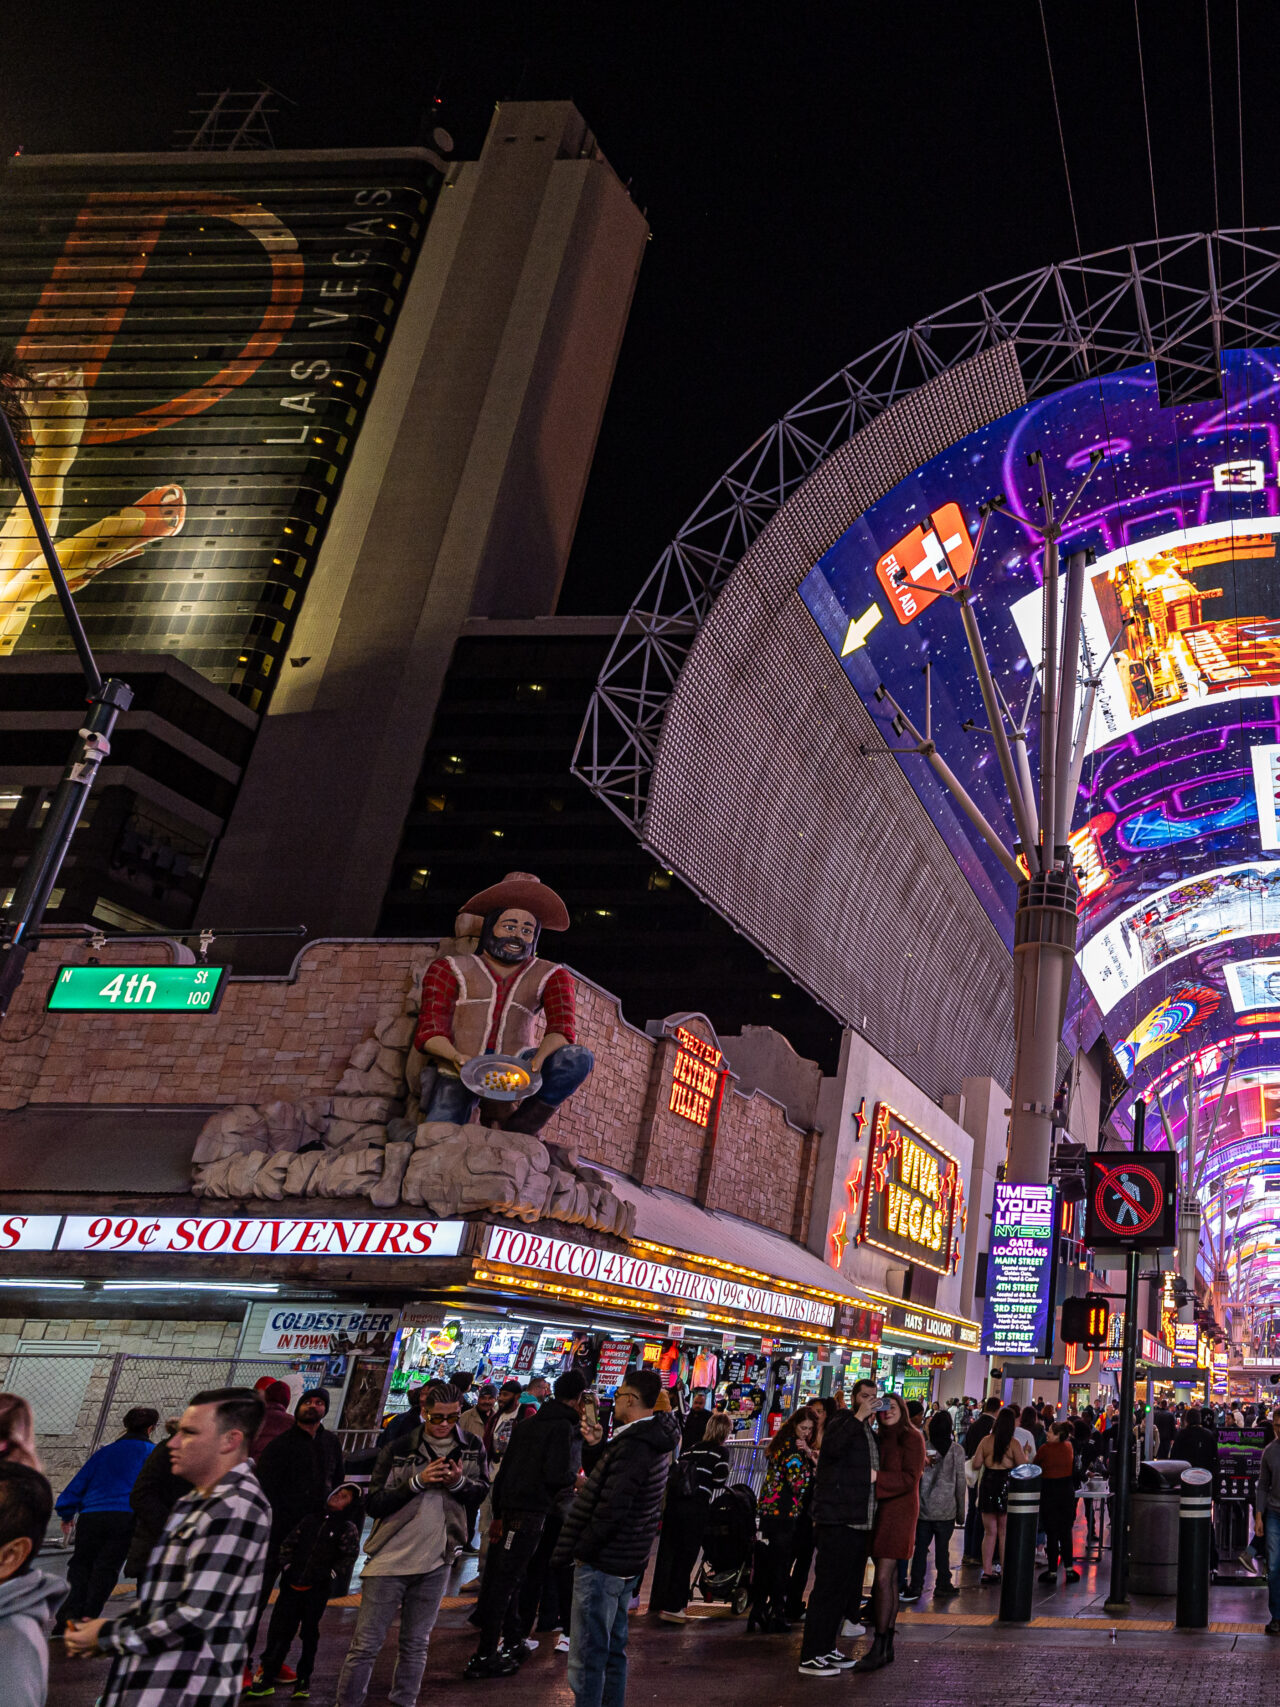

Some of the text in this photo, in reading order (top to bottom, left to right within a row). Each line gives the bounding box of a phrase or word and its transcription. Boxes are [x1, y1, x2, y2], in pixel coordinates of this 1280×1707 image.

[263, 188, 391, 444] LAS VEGAS
[898, 593, 917, 616] AID
[61, 970, 209, 1003] N 4th St
[186, 991, 211, 1005] 100
[673, 1049, 718, 1098] WESTERN
[669, 1081, 711, 1128] VILLAGE
[901, 1136, 939, 1202] VIVA
[996, 1185, 1047, 1199] TIME
[996, 1198, 1052, 1213] YOUR
[888, 1182, 943, 1251] VEGAS
[995, 1211, 1051, 1226] LIFE
[84, 1217, 438, 1253] 99¢ SOUVENIRS
[1009, 1238, 1033, 1247] GATE
[993, 1246, 1048, 1256] LOCATIONS
[994, 1257, 1044, 1265] MAIN STREET
[493, 1229, 598, 1277] TOBACCO
[604, 1255, 648, 1288] 4X10
[650, 1264, 718, 1301] T-SHIRTS
[745, 1288, 807, 1320] SOUVENIRS
[809, 1301, 834, 1326] BEER
[996, 1283, 1038, 1291] 4TH STREET
[994, 1304, 1037, 1313] 3RD STREET
[272, 1312, 393, 1332] COLDEST BEER
[904, 1313, 922, 1331] HATS
[926, 1319, 952, 1338] LIQUOR
[1089, 1308, 1105, 1336] 11
[277, 1334, 331, 1350] IN TOWN
[994, 1332, 1033, 1340] 1ST STREET
[913, 1356, 949, 1366] LIQUOR
[903, 1387, 928, 1397] VAPE
